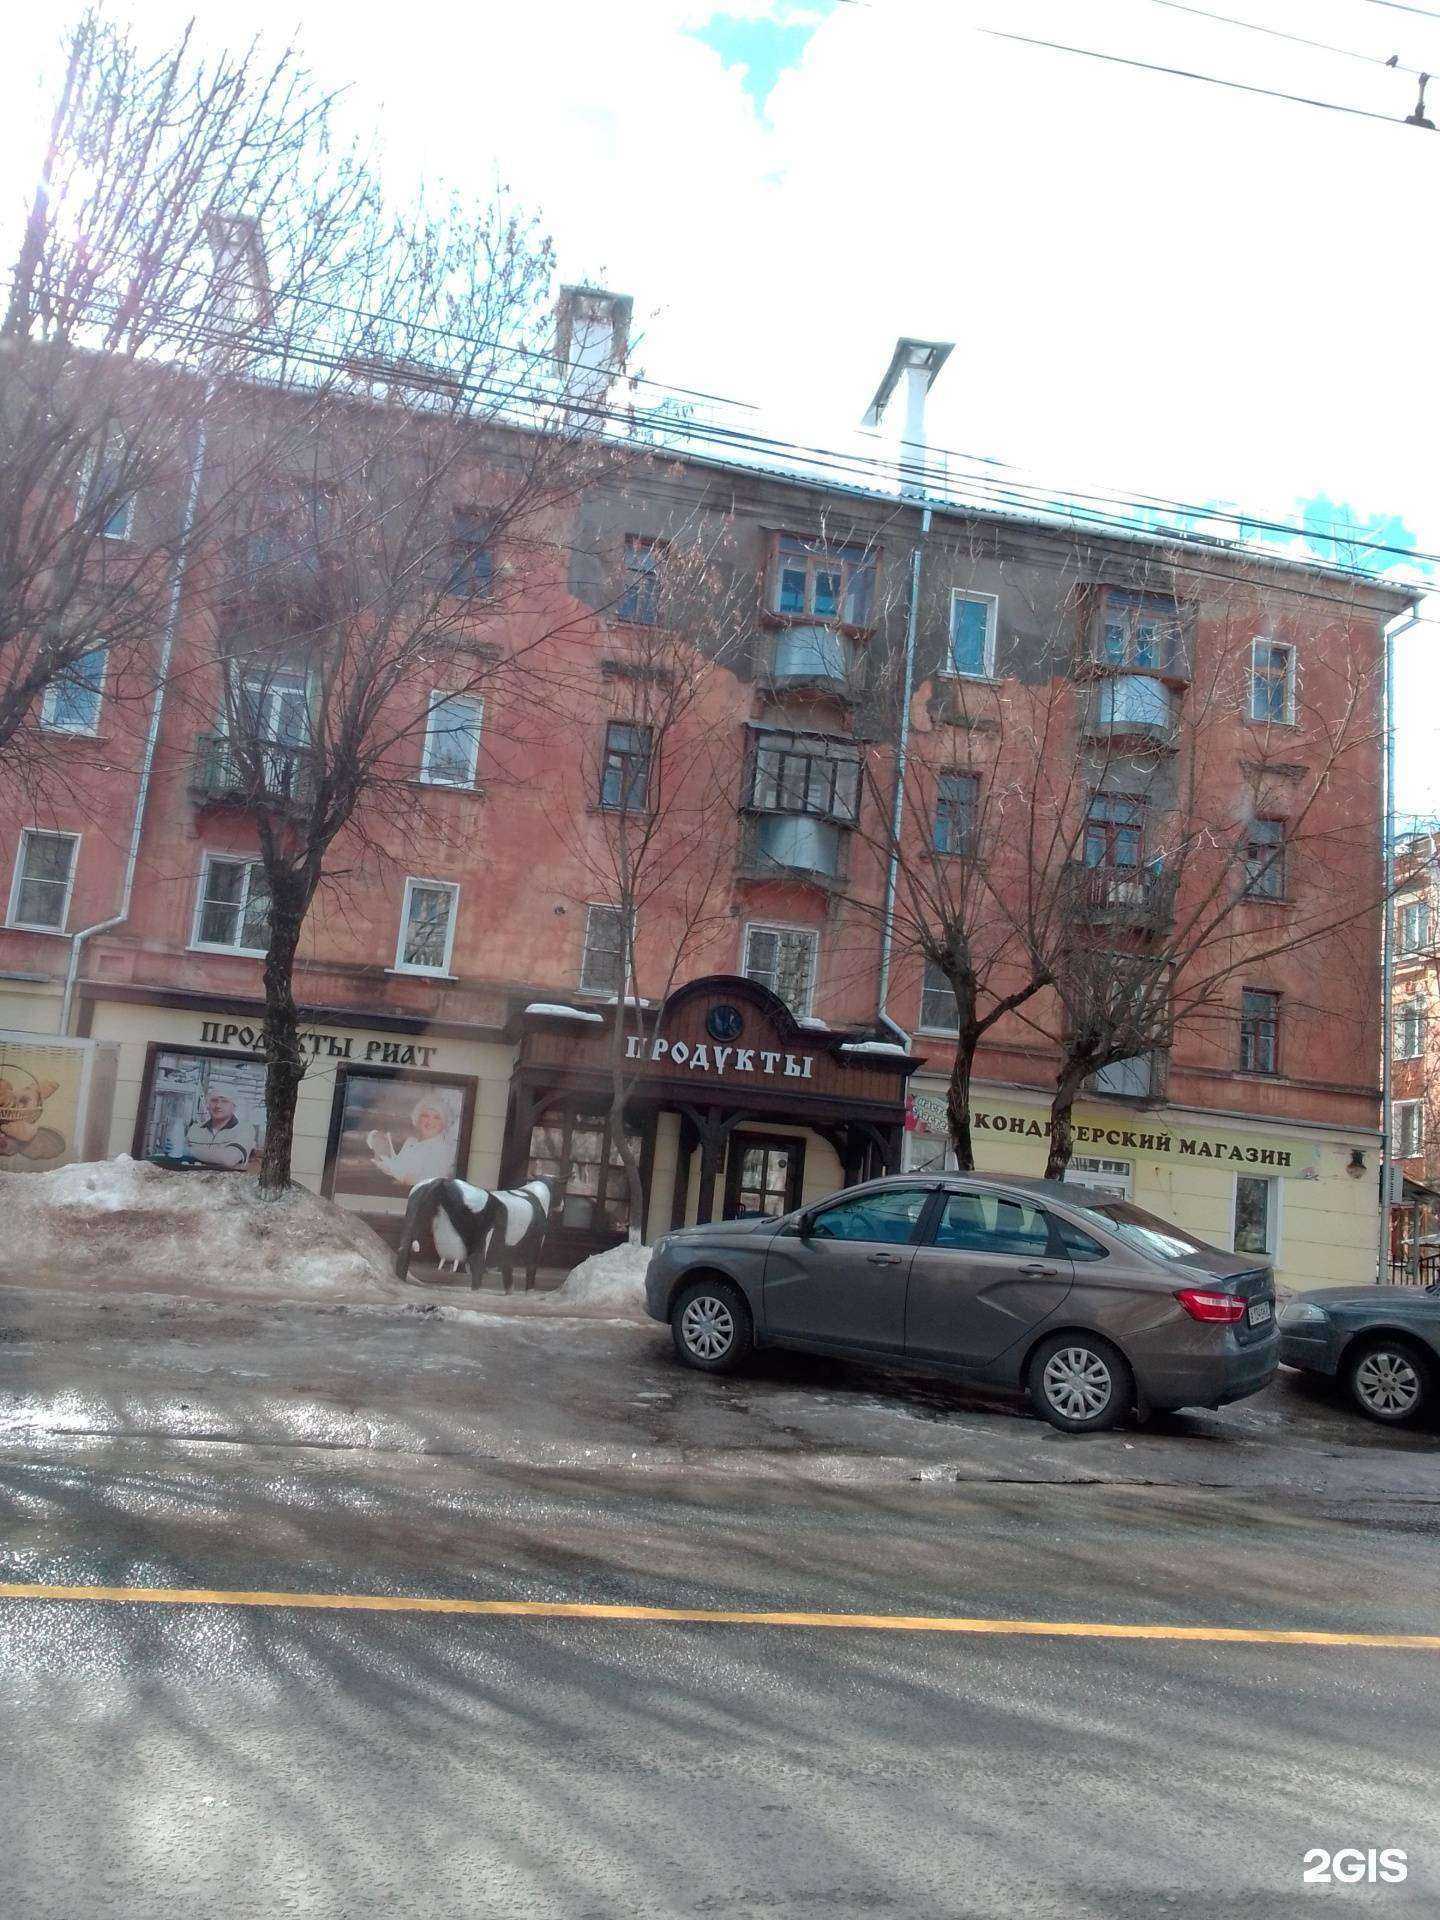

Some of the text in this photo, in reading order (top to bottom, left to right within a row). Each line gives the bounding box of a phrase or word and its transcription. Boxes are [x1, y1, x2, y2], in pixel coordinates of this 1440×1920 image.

[200, 1021, 438, 1067] ПРОДТЫ РИАТ
[625, 1036, 814, 1078] ПРОДУКТЫ
[974, 1112, 1292, 1167] КОНДЕРСКИЙ МАГАЗИН
